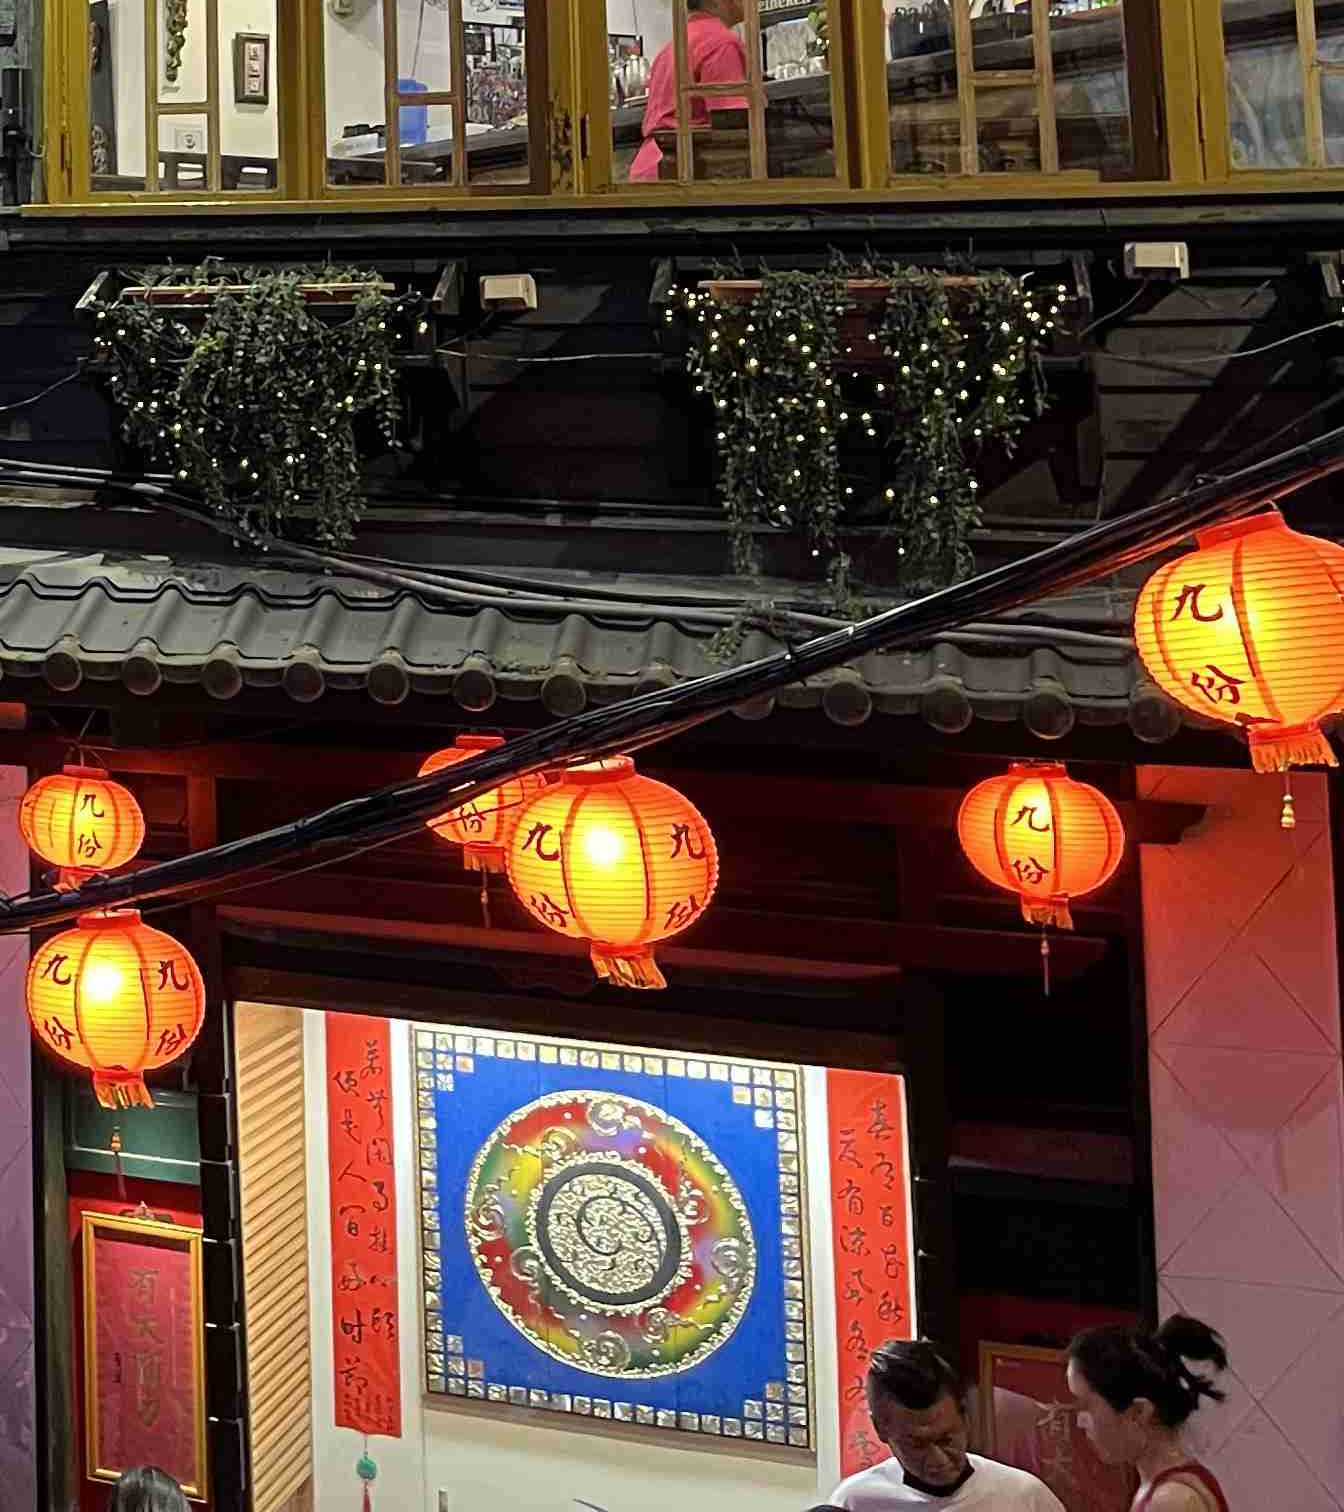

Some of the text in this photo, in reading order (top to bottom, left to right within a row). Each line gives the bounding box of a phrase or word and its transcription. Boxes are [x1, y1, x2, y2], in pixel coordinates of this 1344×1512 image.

[1171, 583, 1247, 705] 九份
[80, 793, 105, 858] 九份
[459, 802, 486, 833] 份
[1010, 805, 1051, 885] 九份
[522, 821, 569, 928] 九份
[664, 822, 706, 930] 九份
[41, 953, 76, 1051] 九份
[154, 959, 190, 1056] 九份
